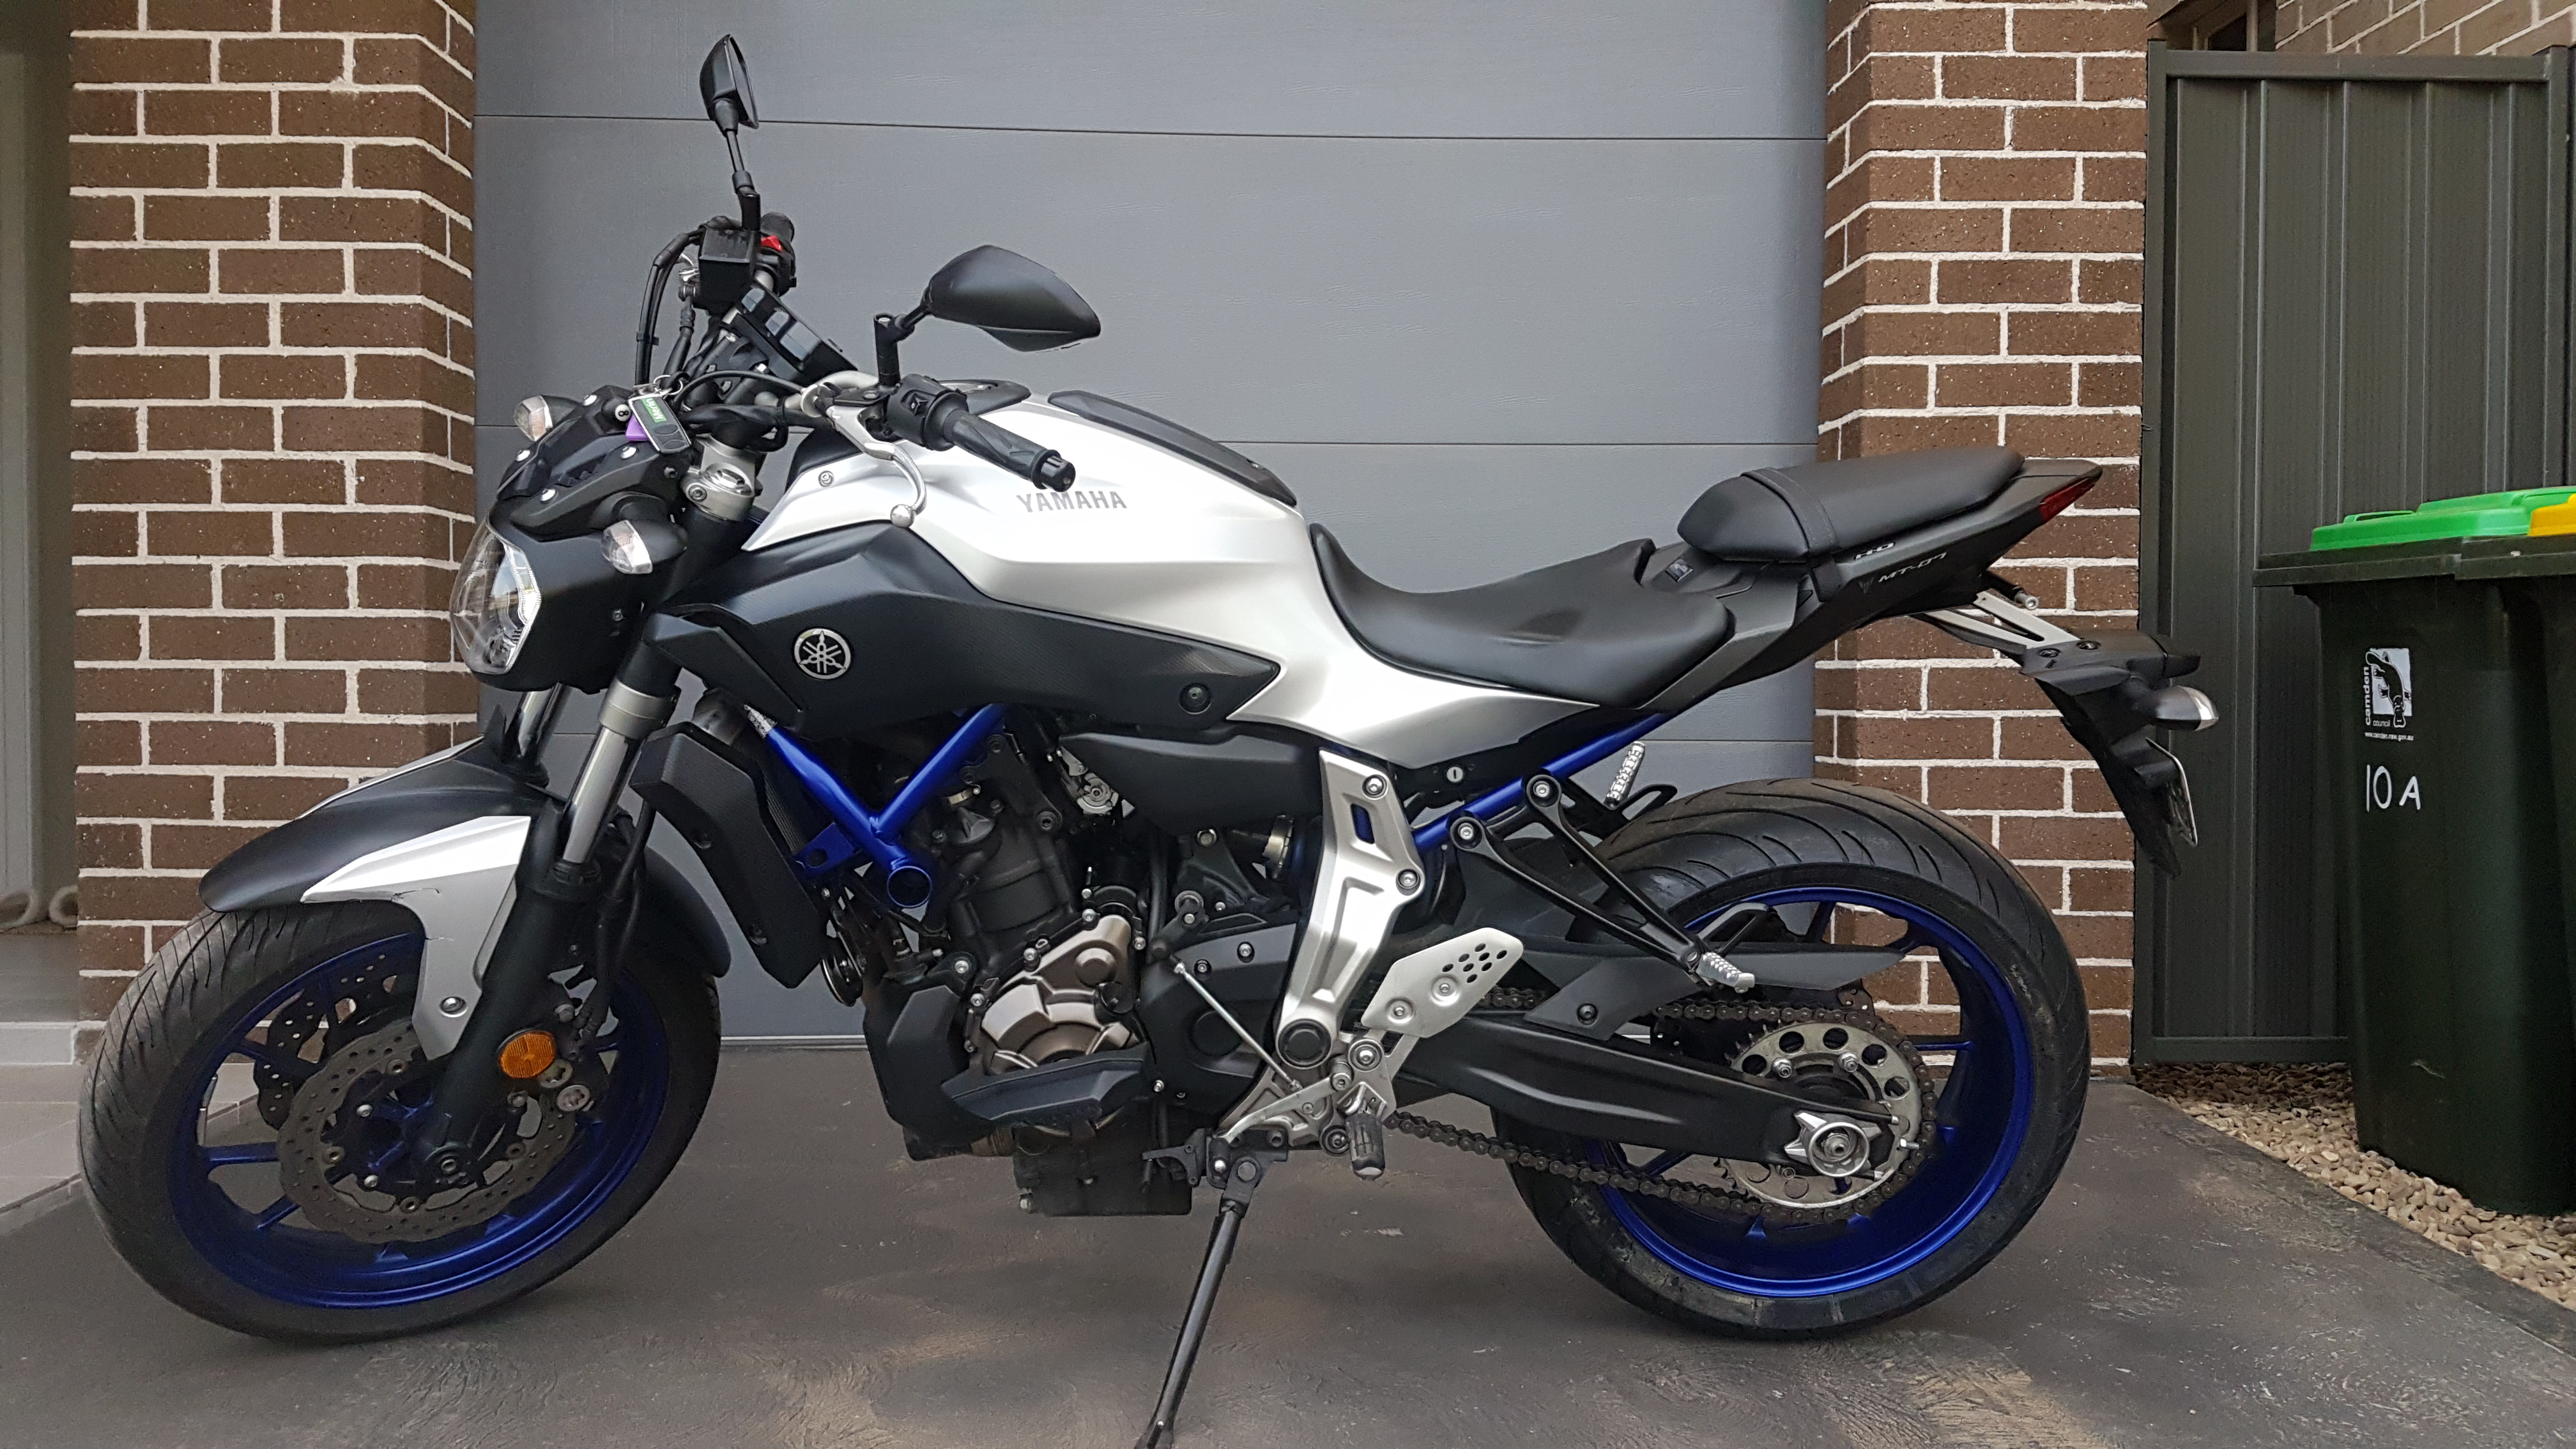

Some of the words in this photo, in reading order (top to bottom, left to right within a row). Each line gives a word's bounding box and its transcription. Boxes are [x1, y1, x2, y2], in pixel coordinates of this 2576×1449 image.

[646, 398, 664, 420] Merlin
[1016, 491, 1127, 512] YAMAHA
[1878, 551, 1947, 583] MT-07
